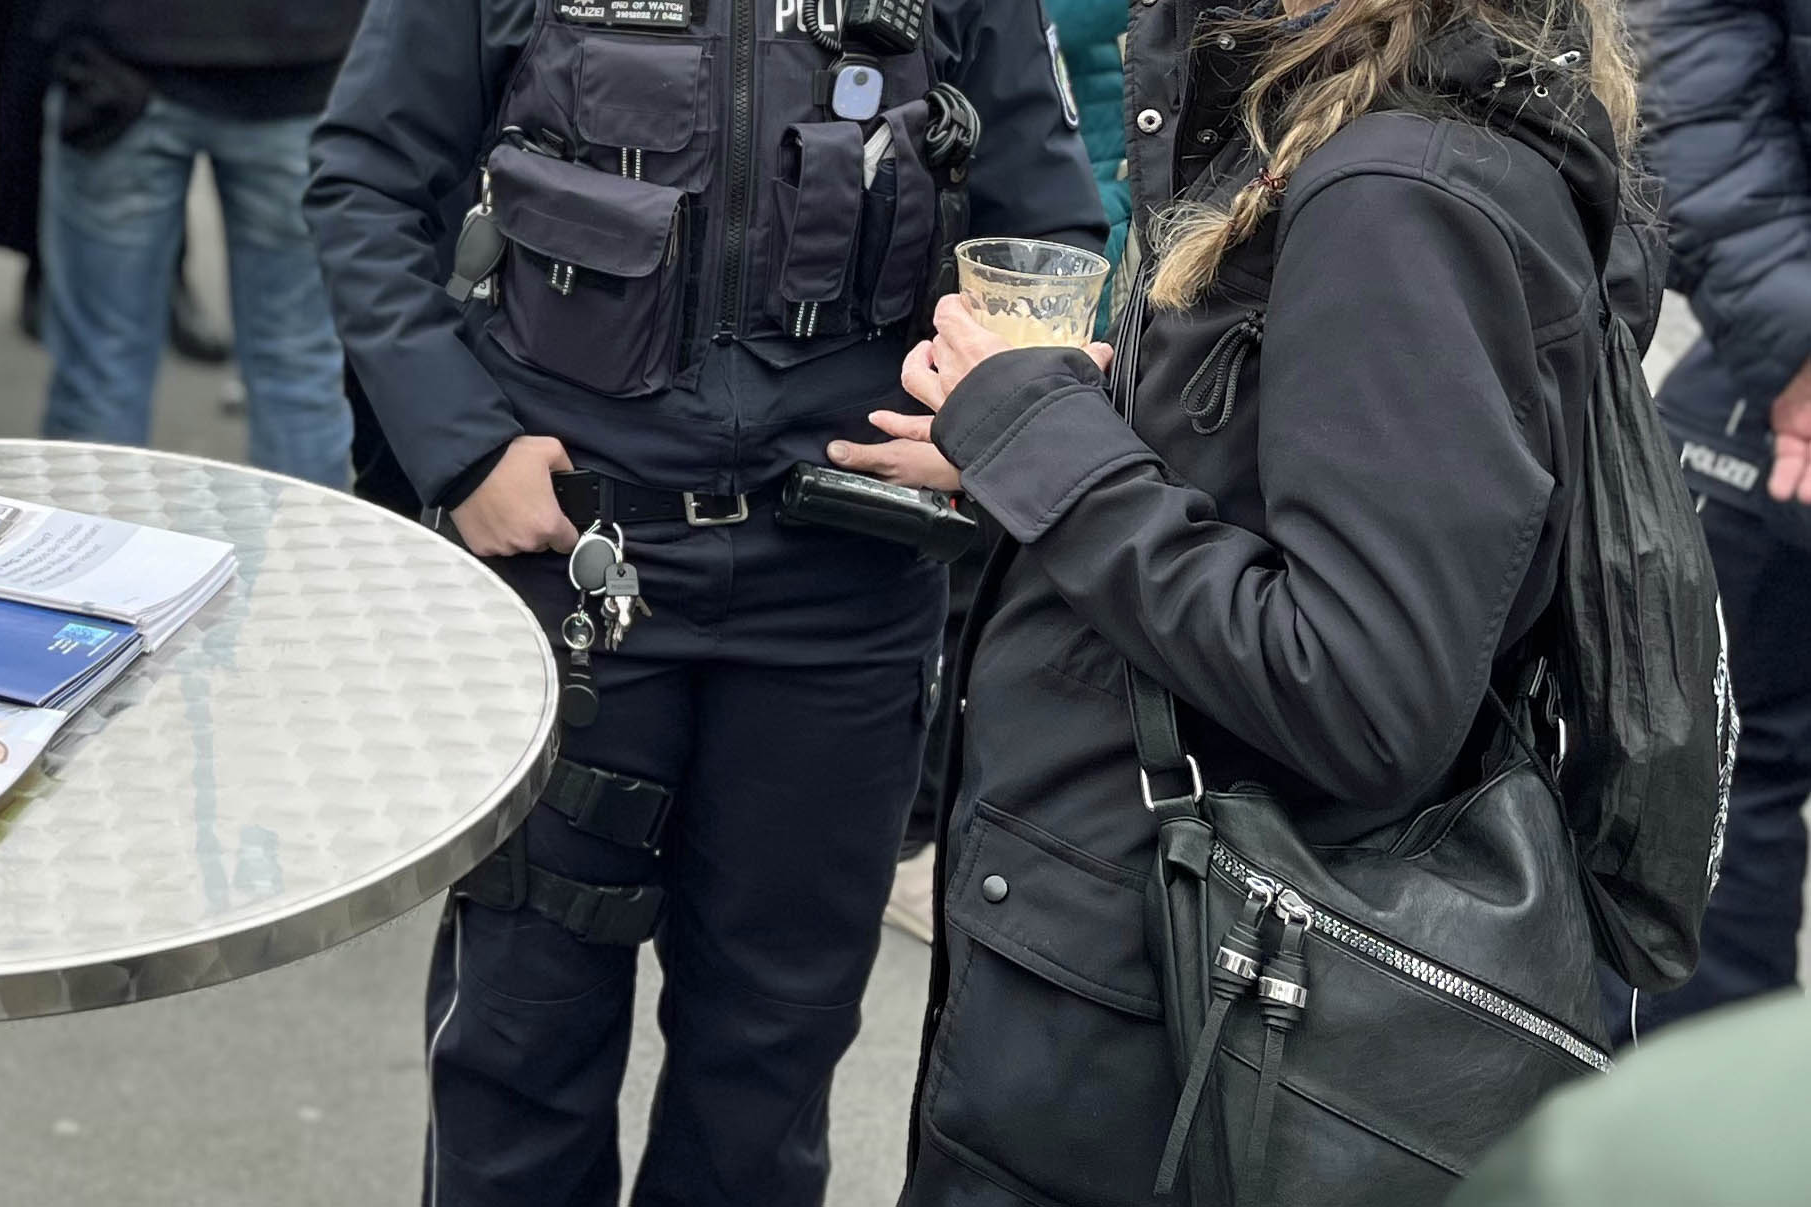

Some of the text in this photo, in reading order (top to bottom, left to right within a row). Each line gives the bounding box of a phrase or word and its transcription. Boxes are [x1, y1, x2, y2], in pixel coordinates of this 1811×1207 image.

[560, 4, 605, 18] POLIZEI
[611, 1, 684, 13] END OF WATCH
[1680, 442, 1760, 491] POLIZEI
